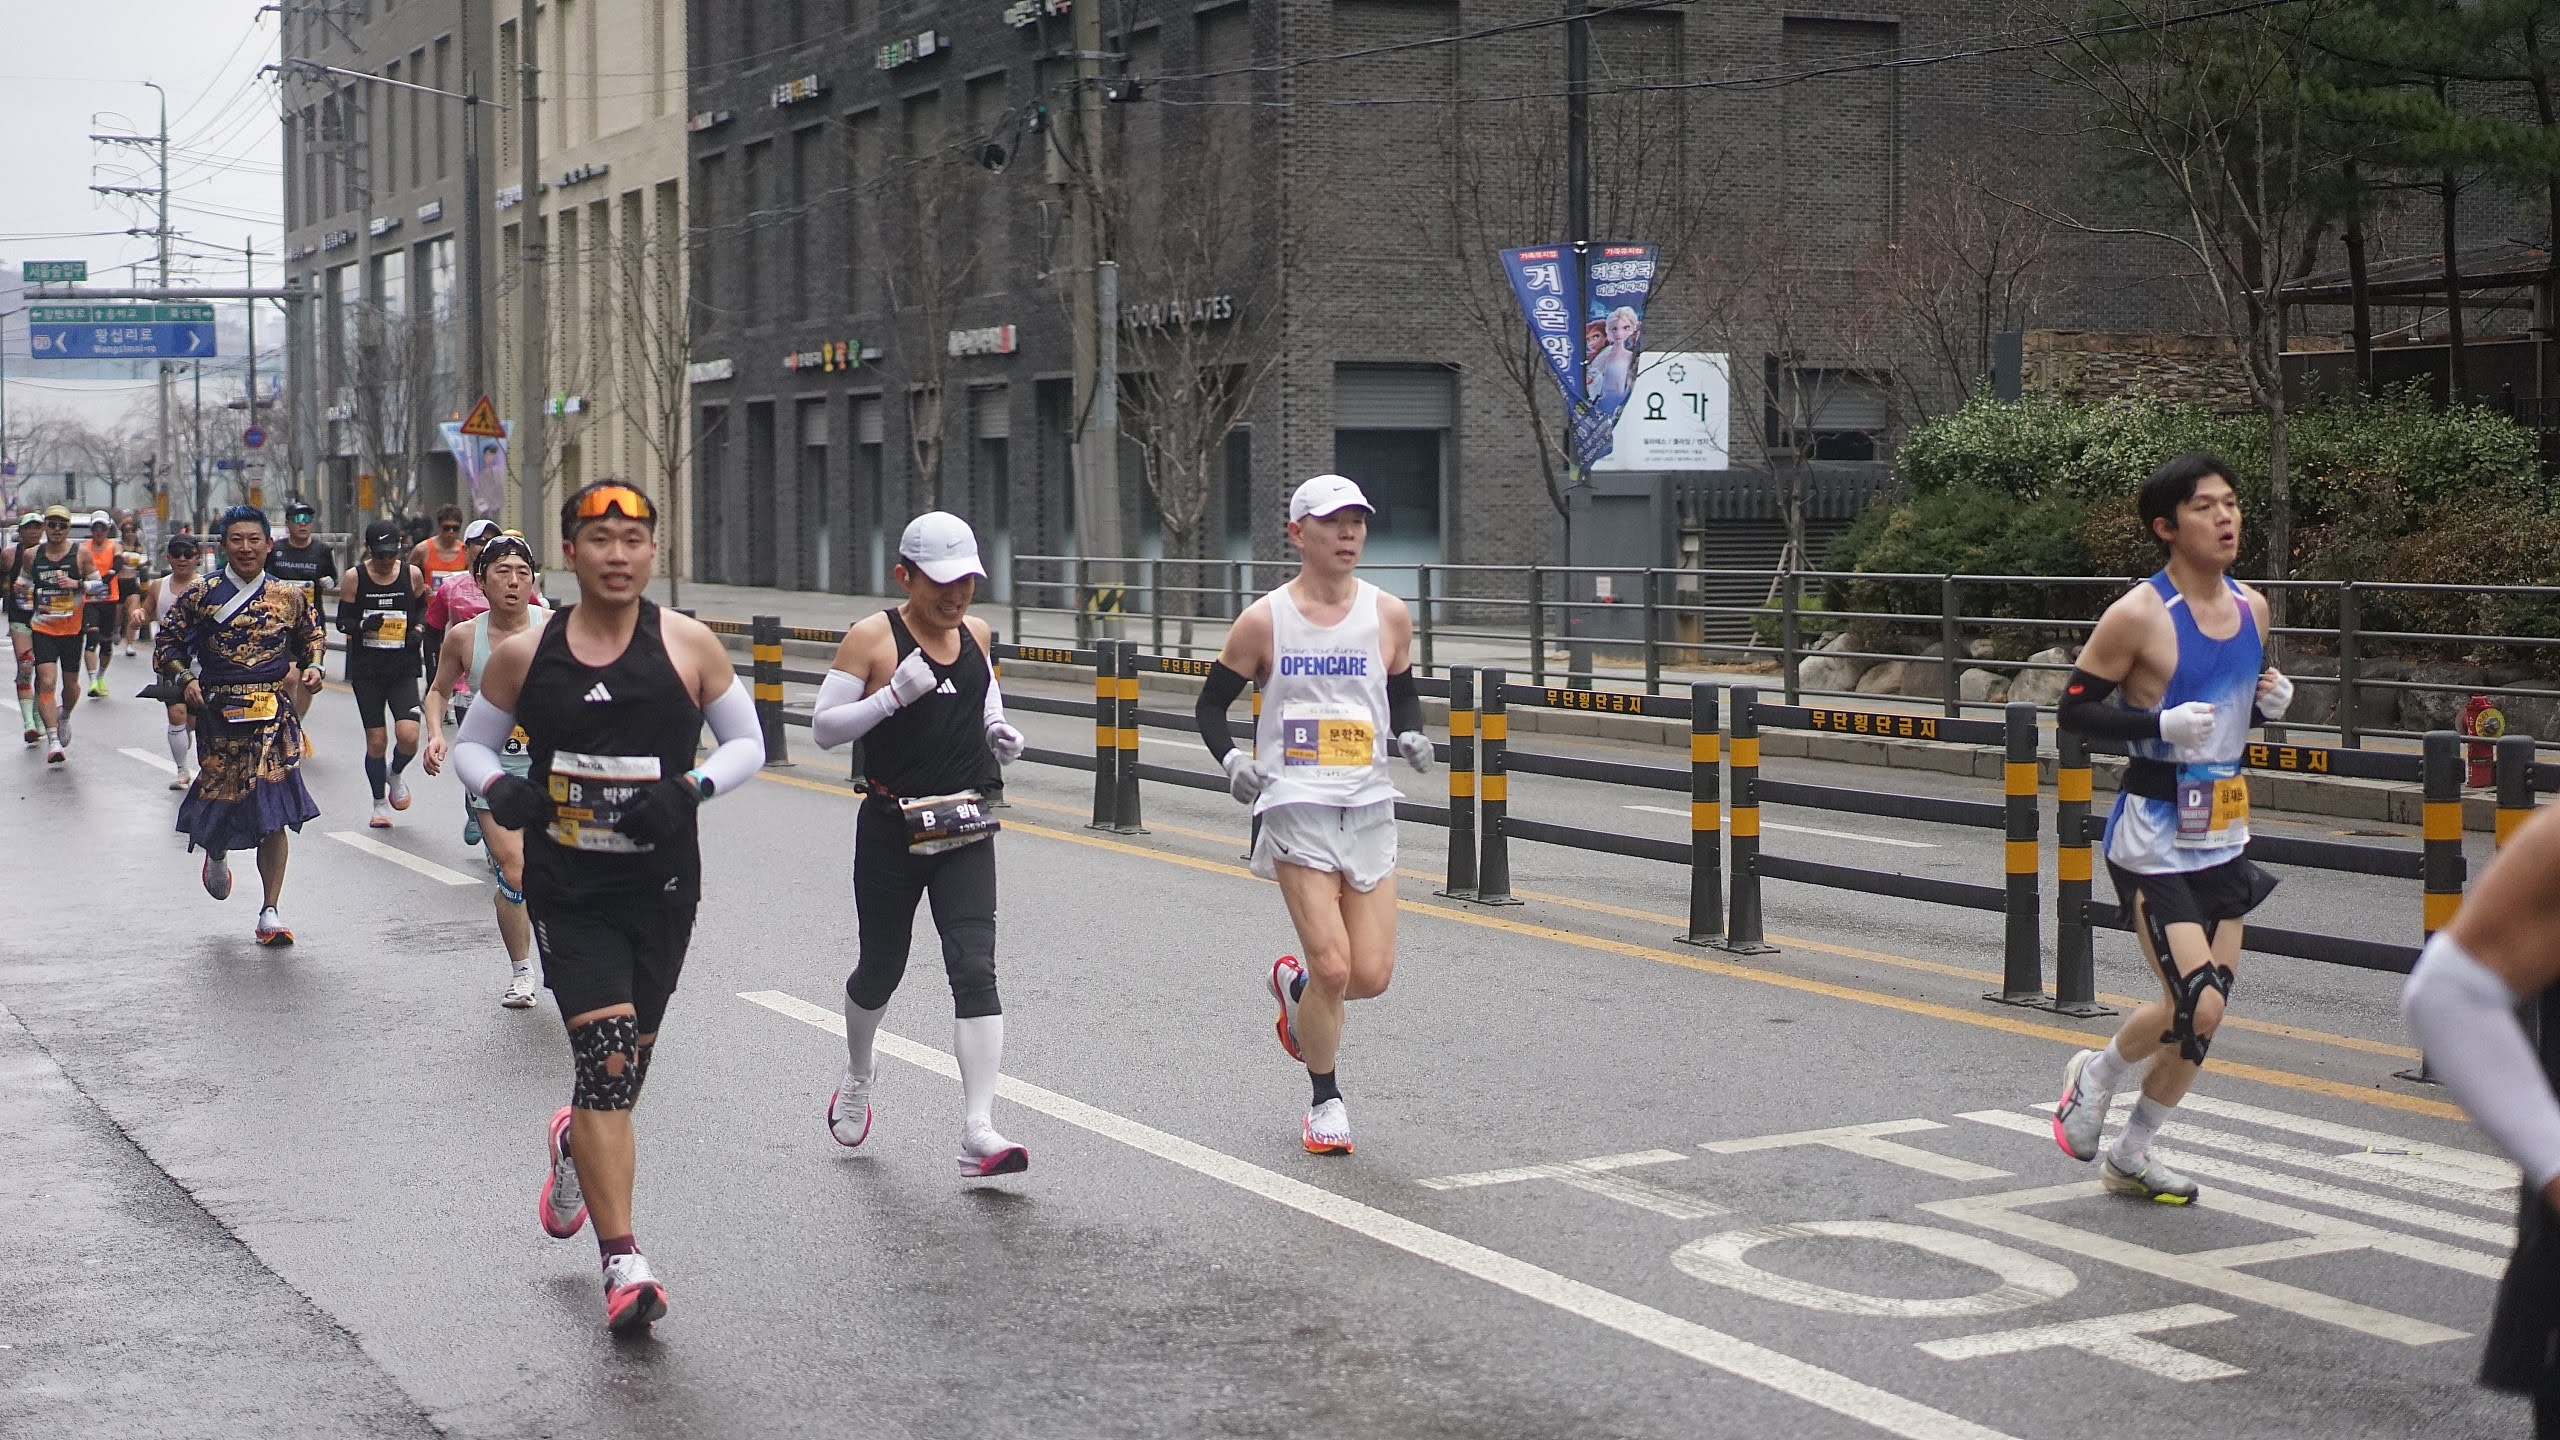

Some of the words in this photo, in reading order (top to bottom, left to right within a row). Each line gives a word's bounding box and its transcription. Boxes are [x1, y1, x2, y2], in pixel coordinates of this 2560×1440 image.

[29, 263, 84, 278] 서울숲입구
[1591, 261, 1655, 280] 겨울왕국
[1523, 263, 1575, 386] 겨울왕
[95, 327, 153, 343] 왕십리로
[1643, 391, 1710, 422] 요가
[275, 561, 318, 570] HUMANRACE
[1019, 646, 1073, 664] 무단횡단금지
[1161, 658, 1212, 676] 무단횡단금
[1281, 655, 1367, 676] OPENCARE
[1546, 689, 1642, 714] 무단횡단금지
[1811, 710, 1937, 740] 무단횡단금지
[1294, 727, 1308, 744] B
[2249, 744, 2329, 773] 단금지
[569, 782, 583, 803] B
[2188, 789, 2201, 807] D
[921, 810, 937, 829] B
